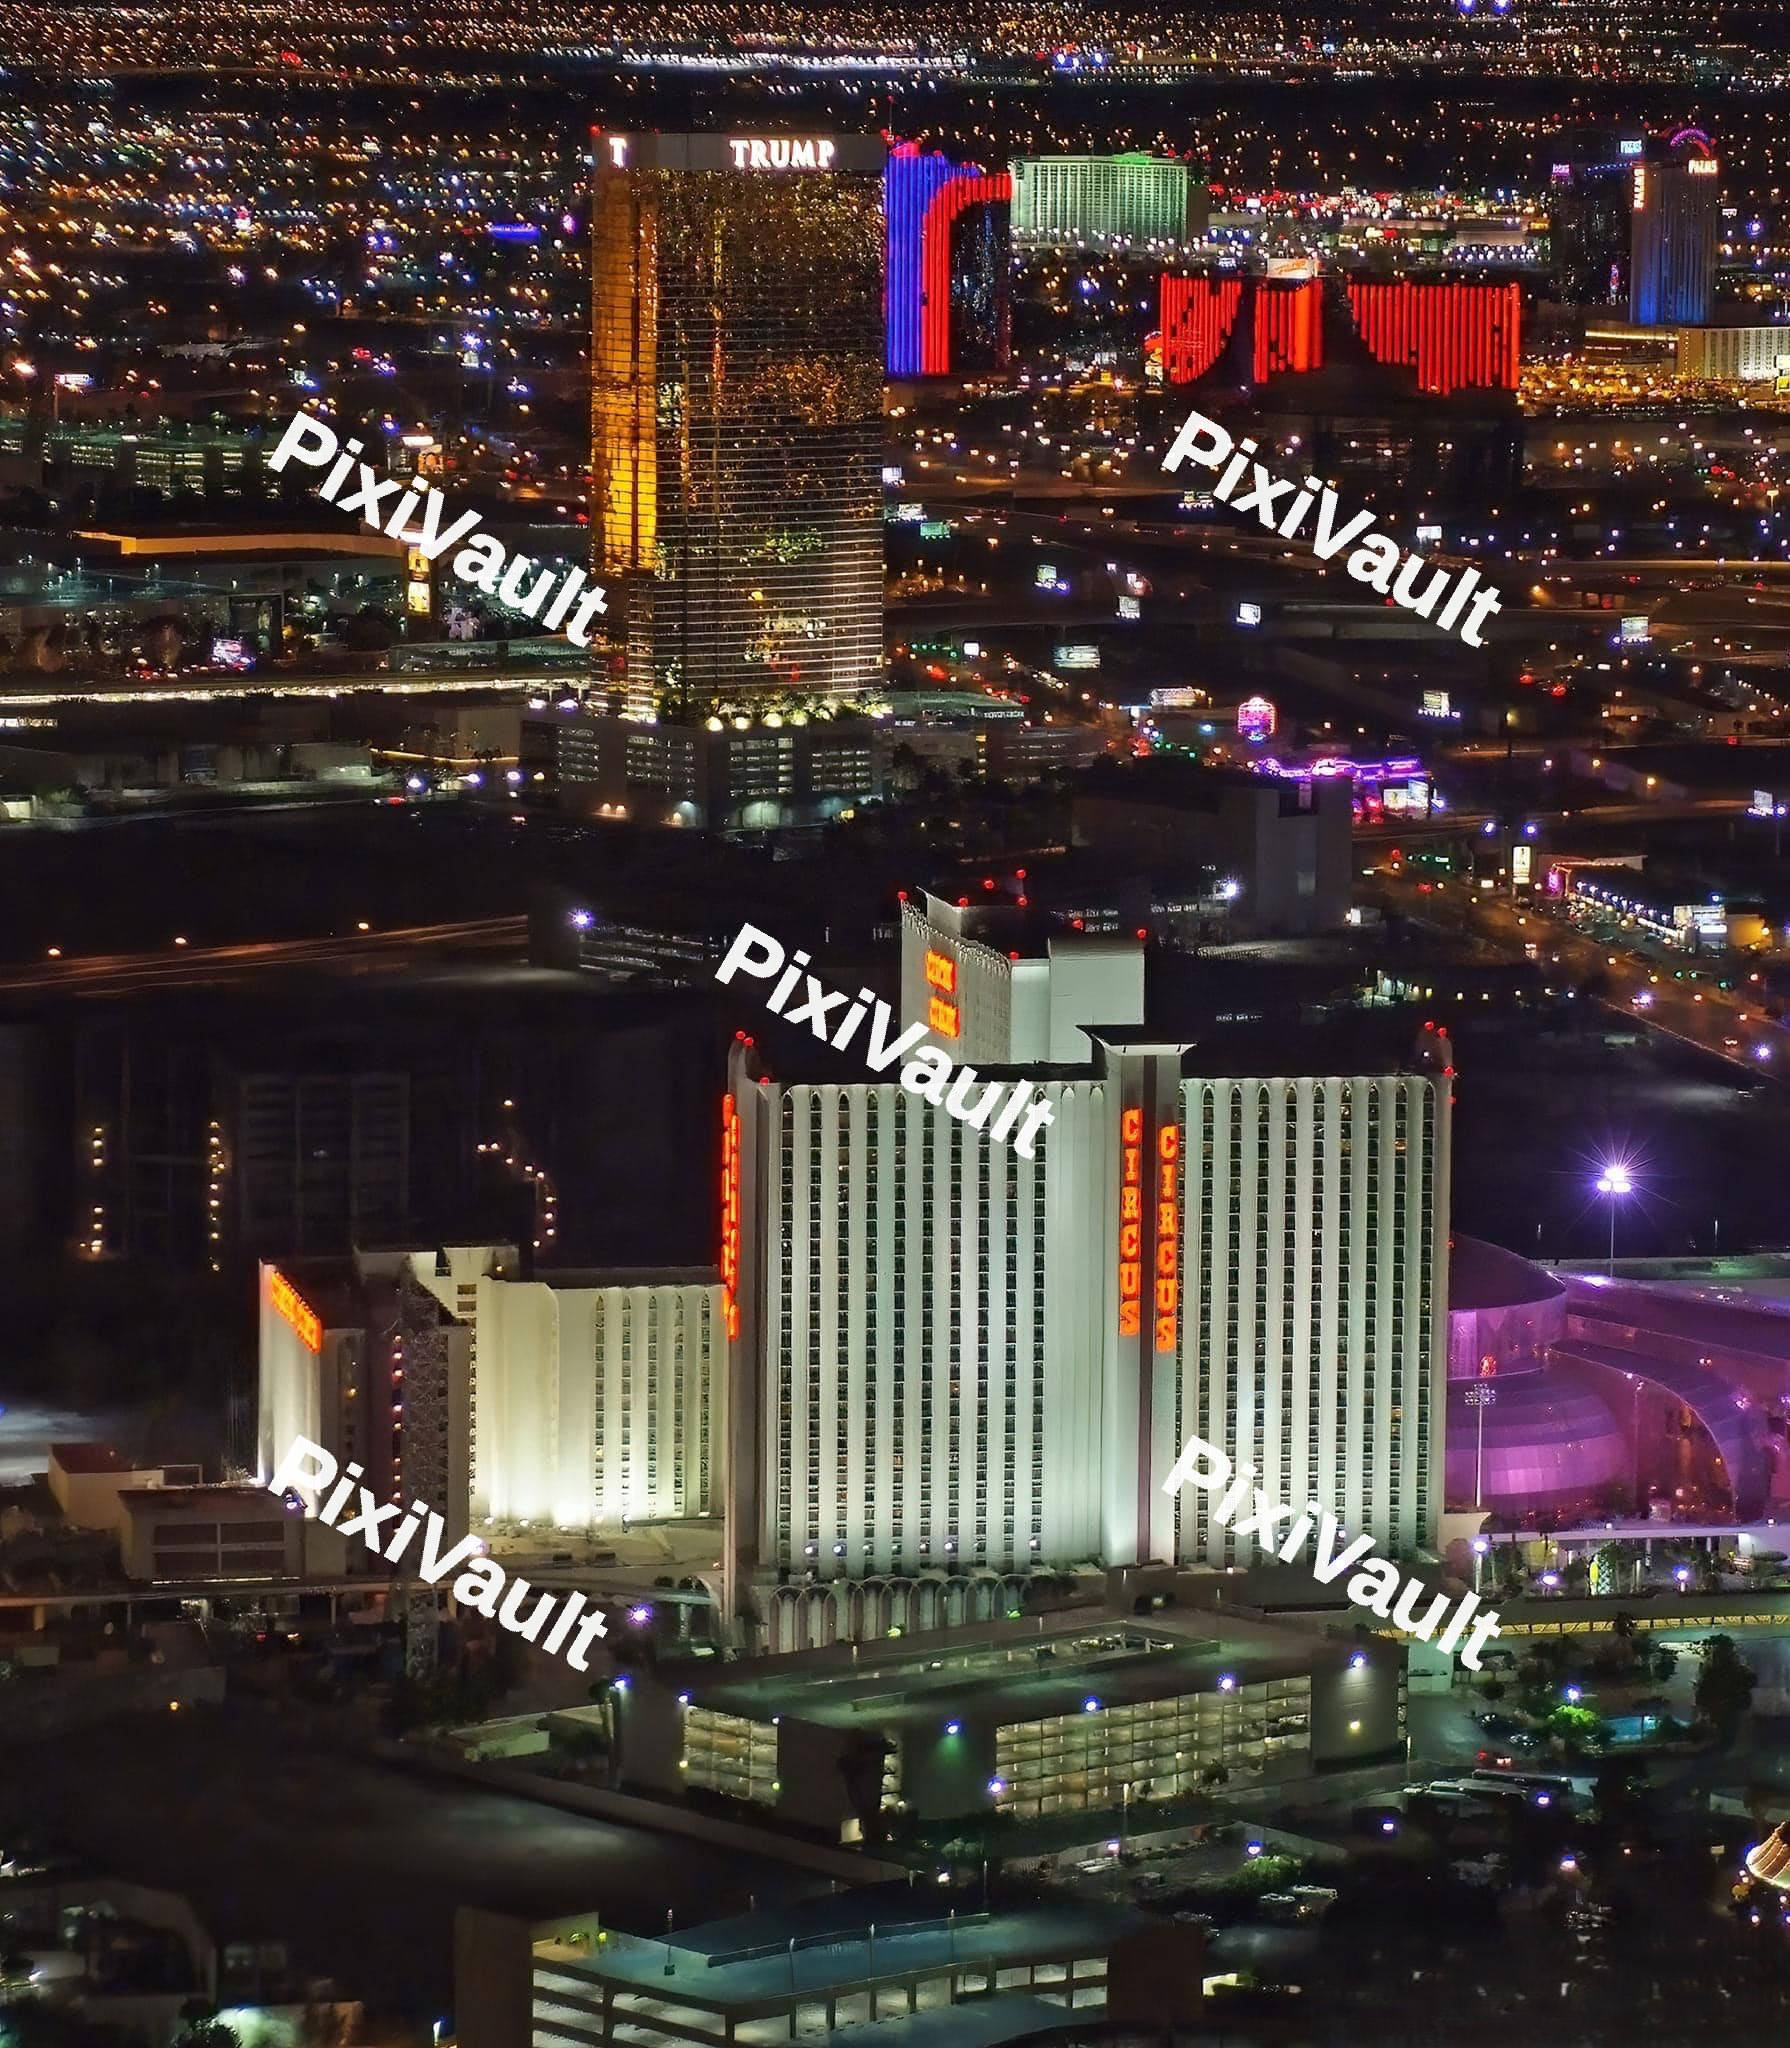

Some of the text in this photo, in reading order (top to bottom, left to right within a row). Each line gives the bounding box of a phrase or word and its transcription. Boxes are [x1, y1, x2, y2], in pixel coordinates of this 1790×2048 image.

[608, 137, 627, 168] T
[729, 139, 835, 169] TRUMP
[1119, 1108, 1143, 1336] CIRCUS
[1155, 1125, 1179, 1352] CIRCUS
